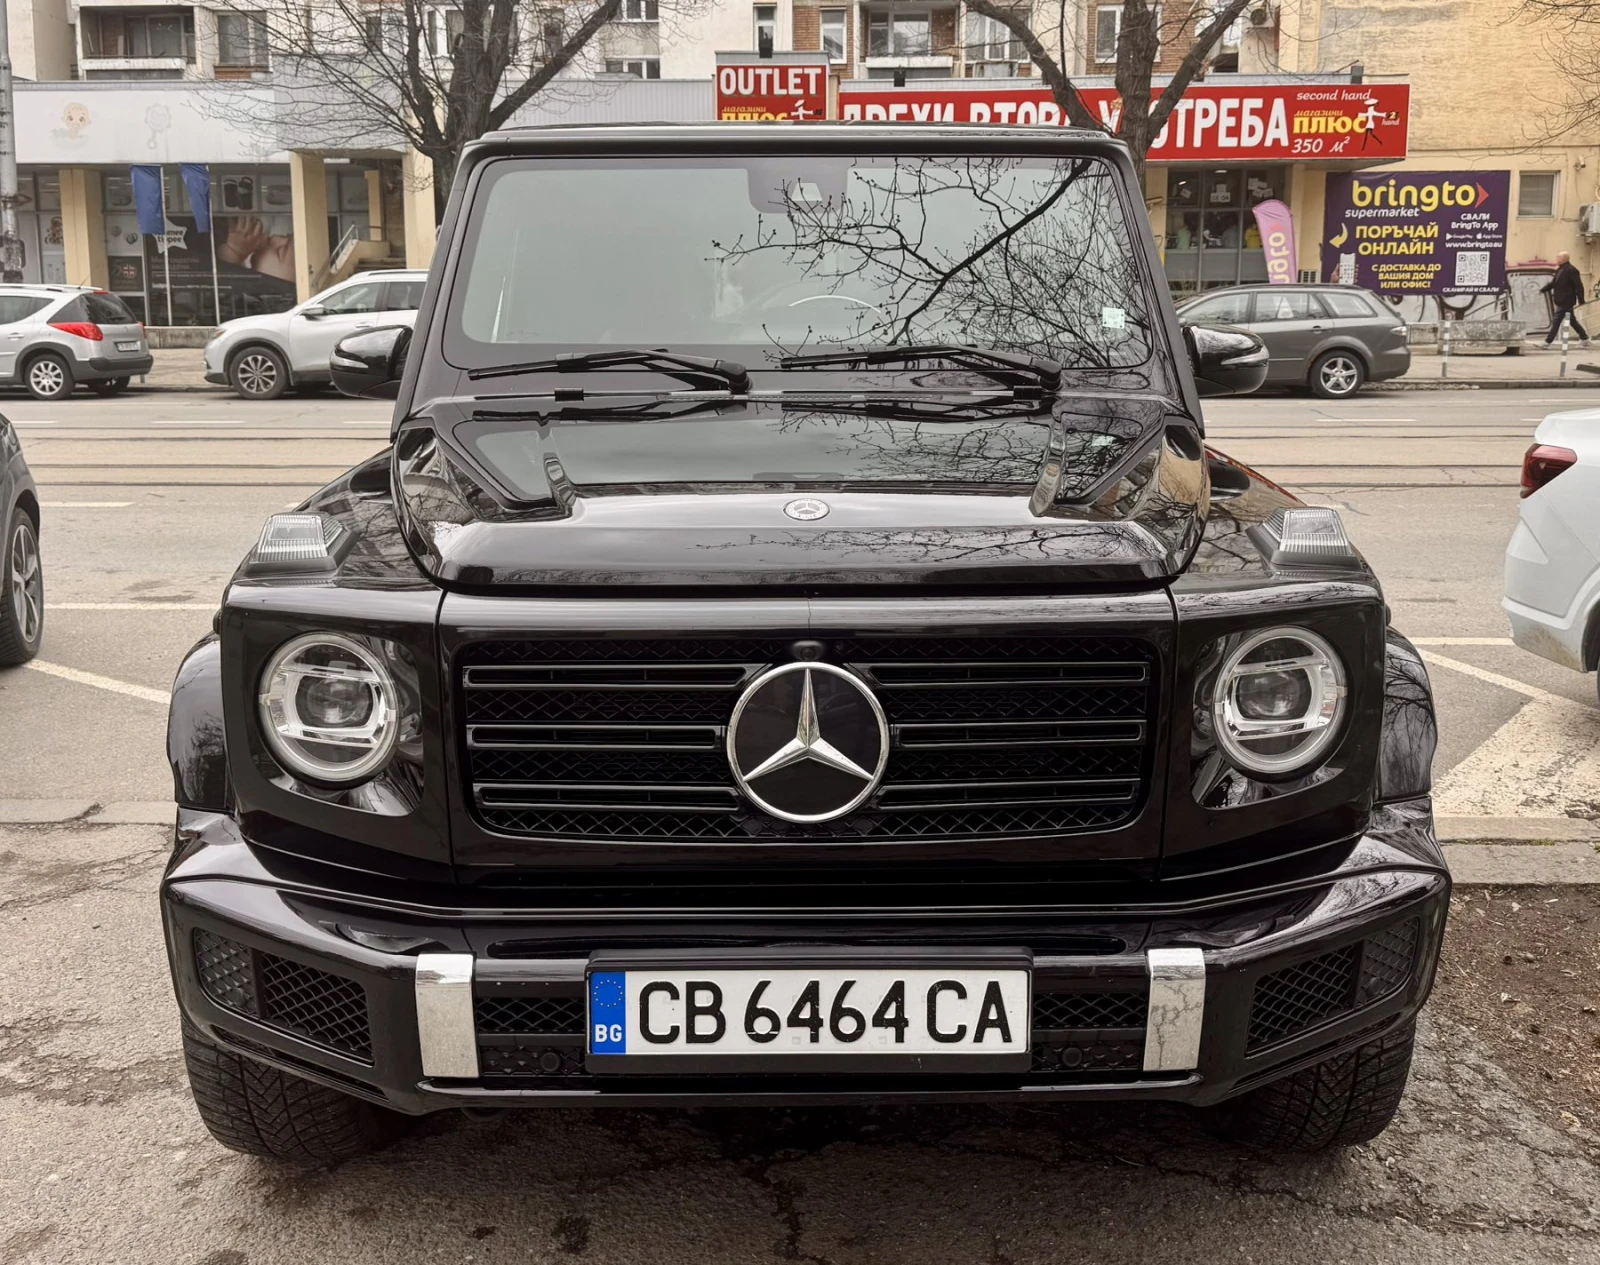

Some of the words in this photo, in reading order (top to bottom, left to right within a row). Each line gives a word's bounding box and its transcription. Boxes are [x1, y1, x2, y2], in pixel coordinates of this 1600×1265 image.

[720, 67, 822, 95] OUTLET
[1296, 89, 1338, 101] second
[1341, 88, 1372, 101] hand
[1294, 109, 1344, 117] магазини
[1389, 111, 1396, 119] 2
[1381, 117, 1401, 126] hand
[1291, 138, 1323, 153] 350
[1352, 179, 1475, 212] bringto
[1345, 207, 1420, 219] supermarket
[1460, 213, 1490, 221] СВАЛИ
[1355, 222, 1439, 239] ПОРЪЧАЙ
[1451, 221, 1481, 230] BringTo
[1482, 222, 1499, 231] App
[157, 236, 182, 244] tipee
[1358, 238, 1434, 255] ОНЛАЙН
[1371, 264, 1378, 272] С
[1379, 264, 1426, 272] ДОСТАВКА
[1427, 263, 1442, 272] ДО
[1378, 272, 1411, 280] ВАШИЯ
[1412, 272, 1434, 280] ДОМ
[1401, 281, 1431, 289] ОФИС!
[639, 980, 726, 1045] CB
[743, 980, 910, 1045] 6464
[926, 979, 1013, 1044] CA
[594, 1023, 623, 1043] BG
